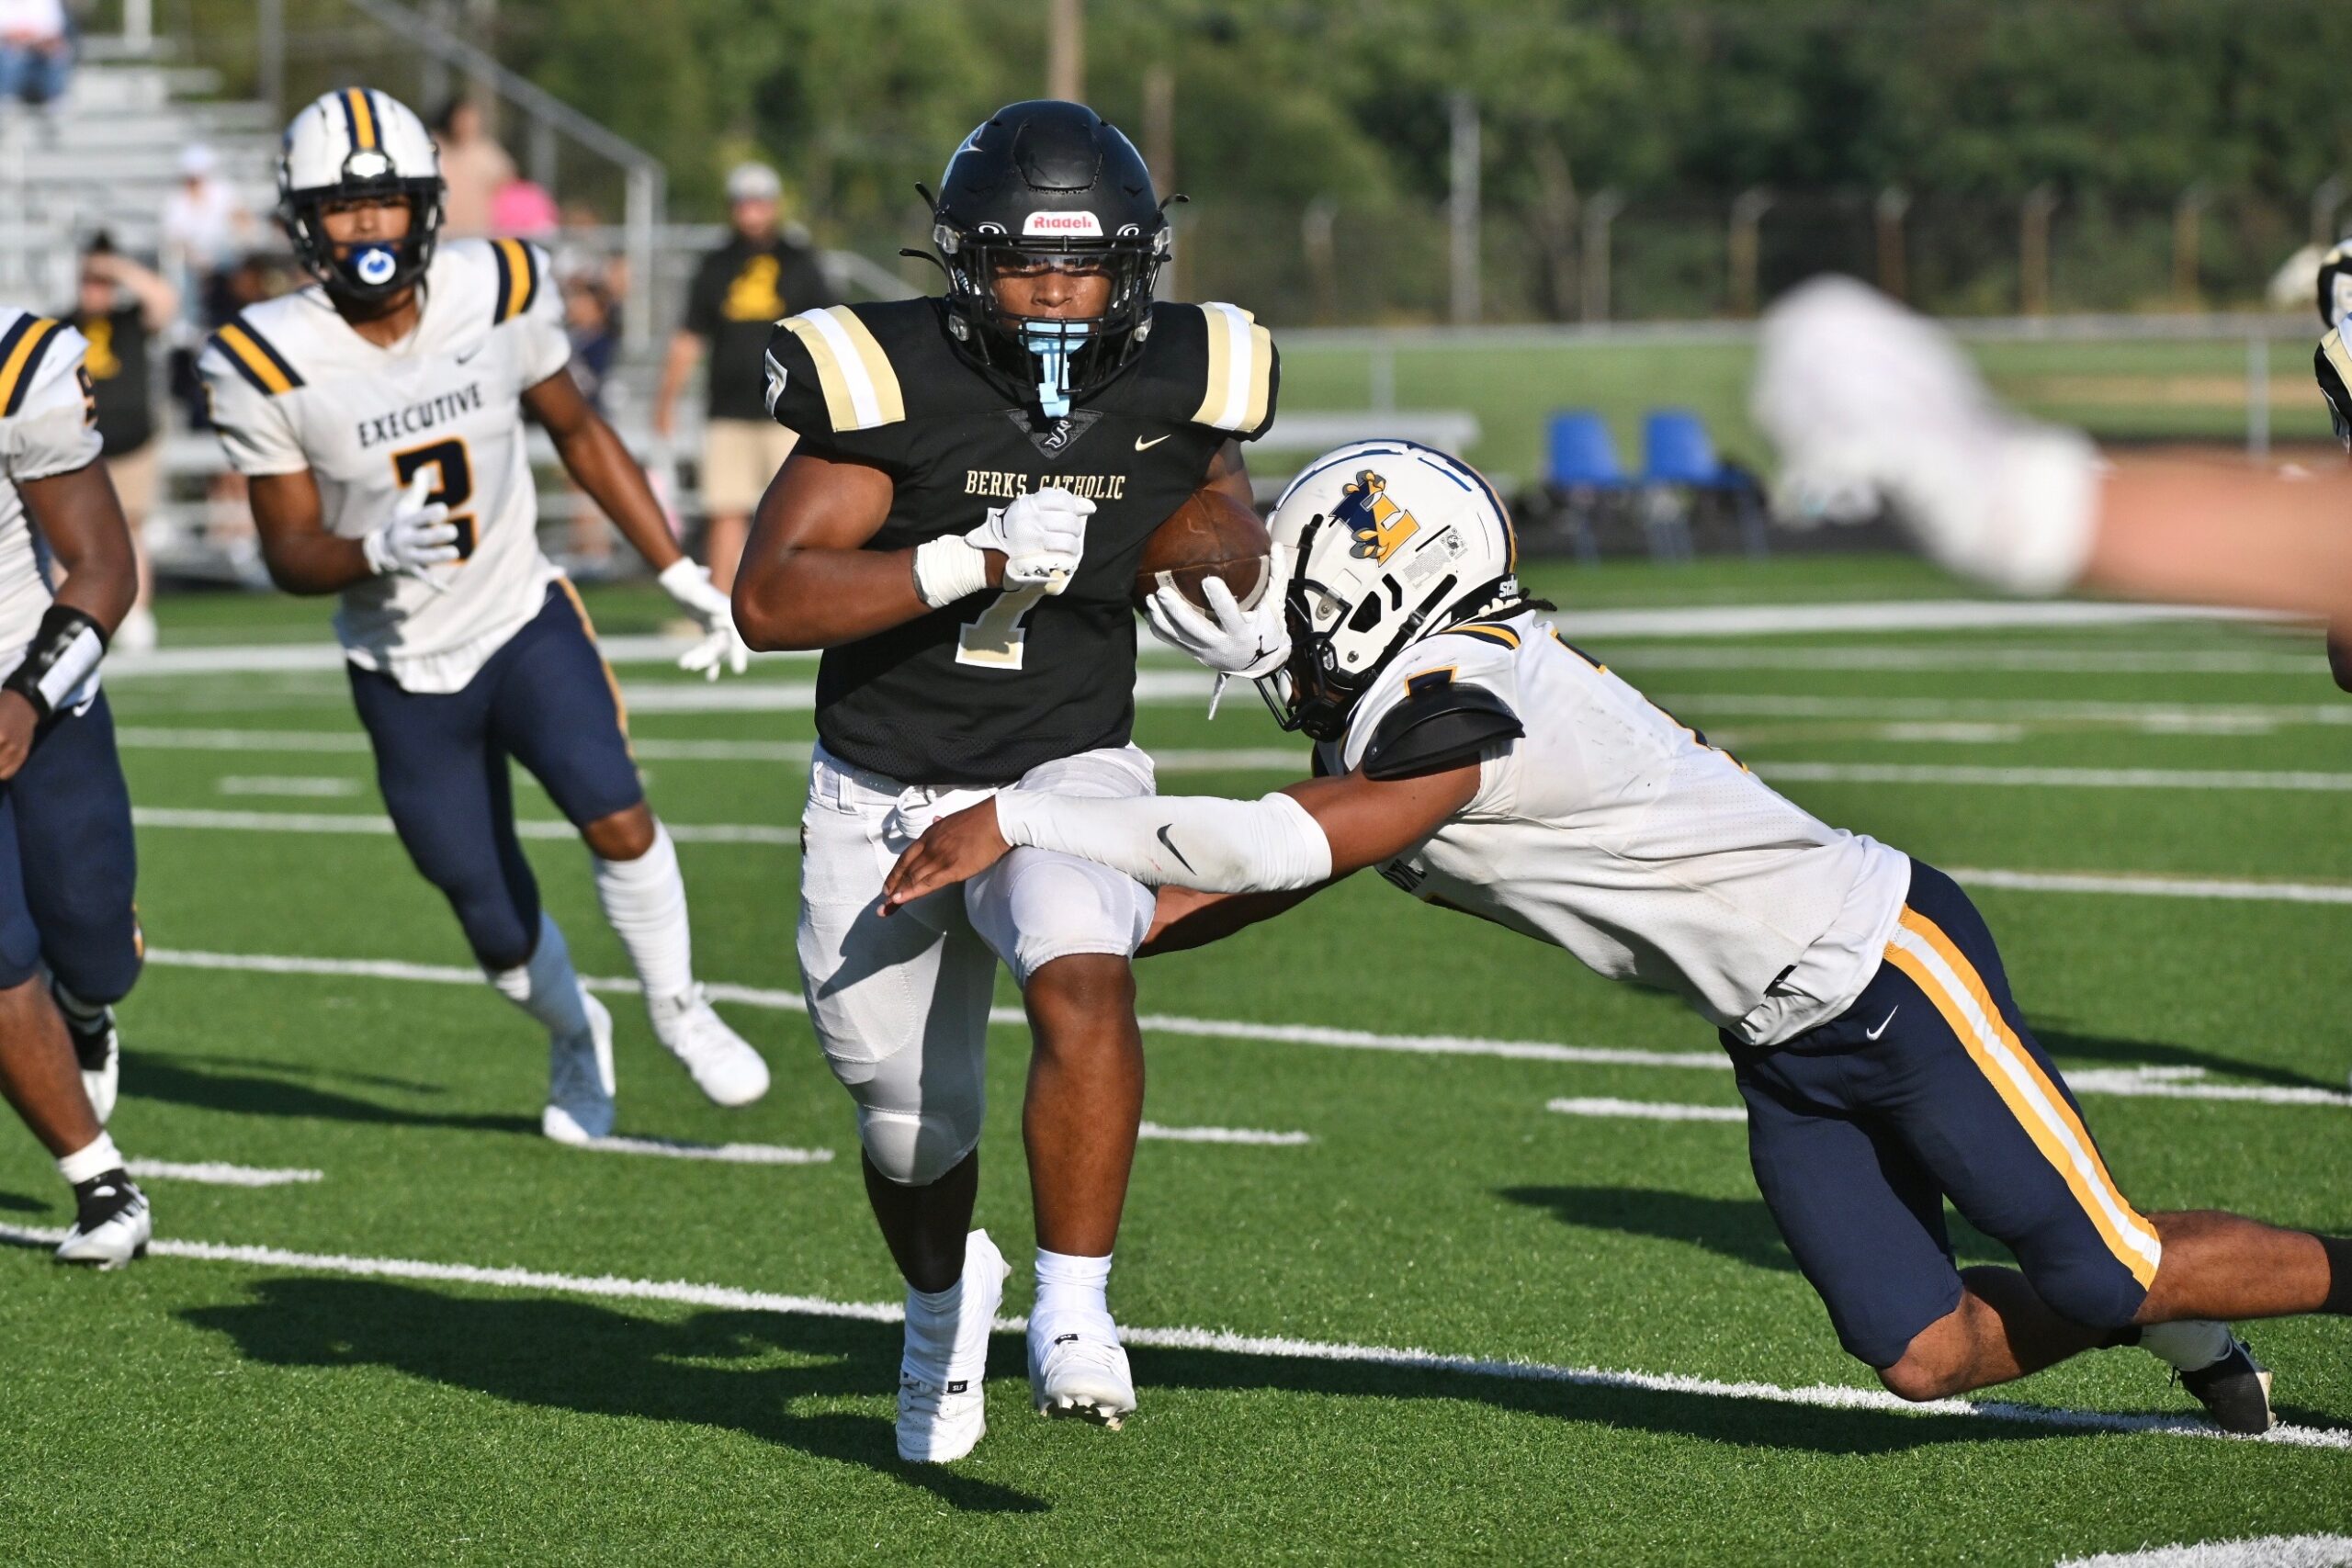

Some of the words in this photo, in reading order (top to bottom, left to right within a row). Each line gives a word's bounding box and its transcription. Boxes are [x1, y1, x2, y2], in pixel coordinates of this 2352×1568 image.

[357, 381, 483, 449] EXECUTIVE
[965, 469, 1027, 499] BERKS
[1039, 475, 1126, 500] CATHOLIC
